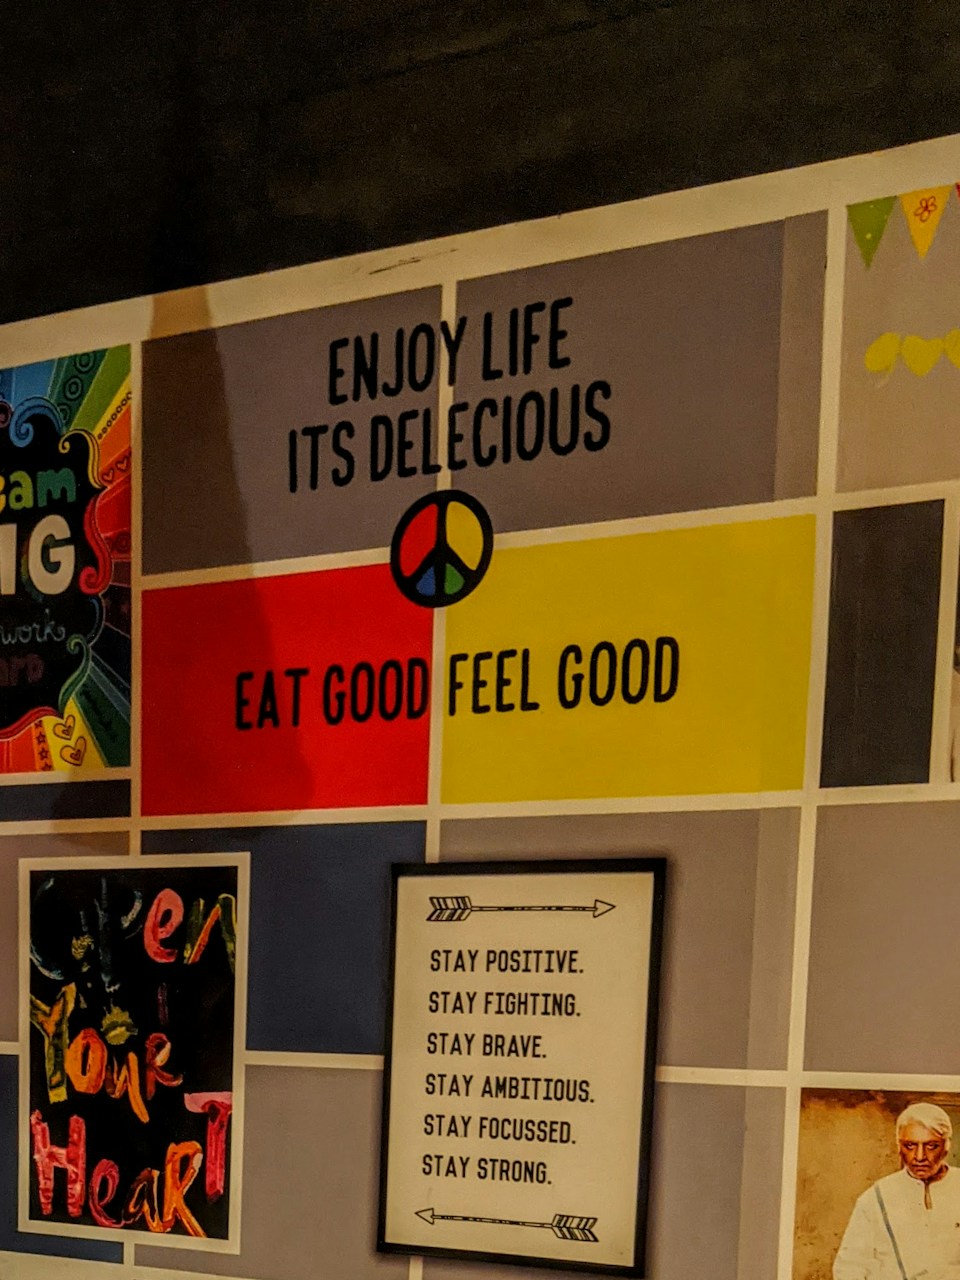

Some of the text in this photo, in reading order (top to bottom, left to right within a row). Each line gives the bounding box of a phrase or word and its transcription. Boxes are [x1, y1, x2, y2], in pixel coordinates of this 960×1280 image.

[328, 297, 573, 405] ENJOY LIFE
[289, 380, 611, 493] ITS DELECIOUS
[448, 637, 680, 717] FEEL GOOD
[235, 657, 430, 730] EAT GOOD
[430, 950, 584, 974] STAY POSITIVE.
[429, 992, 581, 1017] STAY FIGHTING.
[427, 1033, 547, 1059] STAY BRAVE.
[425, 1074, 595, 1103] STAY AMBITIOUS.
[424, 1115, 576, 1145] STAY FOCUSSED.
[422, 1155, 552, 1185] STAY STRONG.
